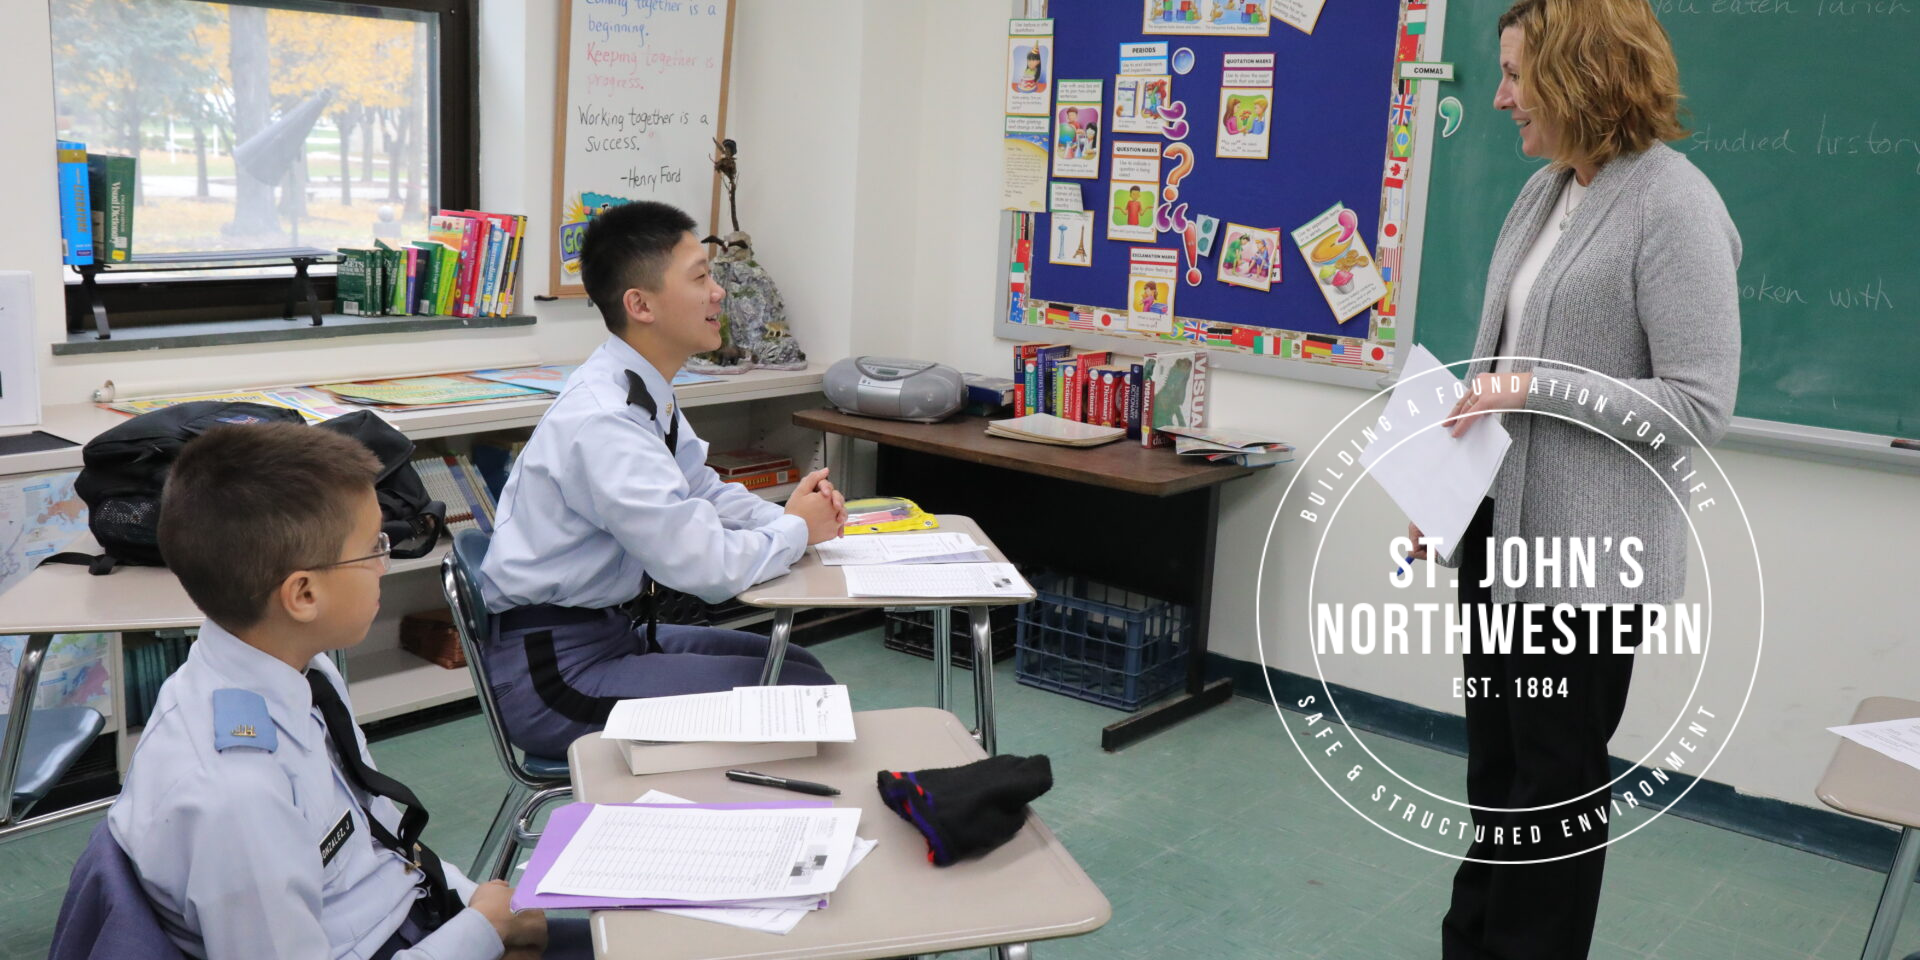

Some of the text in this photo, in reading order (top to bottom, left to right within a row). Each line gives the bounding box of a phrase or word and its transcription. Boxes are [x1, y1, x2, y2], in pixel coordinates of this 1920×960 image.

[637, 0, 681, 19] together
[690, 0, 698, 16] is
[707, 4, 716, 16] a
[588, 14, 649, 48] beginning.
[587, 41, 638, 76] Keeping
[706, 55, 714, 69] is
[1132, 46, 1156, 54] PERIODS
[587, 73, 645, 98] progress.
[1413, 67, 1444, 75] COMMAS
[578, 103, 709, 134] Working together is a
[660, 165, 681, 184] Ford
[73, 184, 88, 233] LITERATURE
[109, 181, 121, 244] Visual Dictionary
[488, 242, 500, 281] Intermediate
[1739, 272, 1894, 311] oken with
[1063, 377, 1071, 414] Dictionary
[1088, 380, 1096, 416] Dictionary
[1101, 385, 1110, 420] Dictionary
[1122, 385, 1131, 423] Dictionary
[1129, 384, 1137, 420] DICTIONARY
[1143, 382, 1151, 413] VISUAL
[321, 820, 350, 859] ONZALEZ, J
